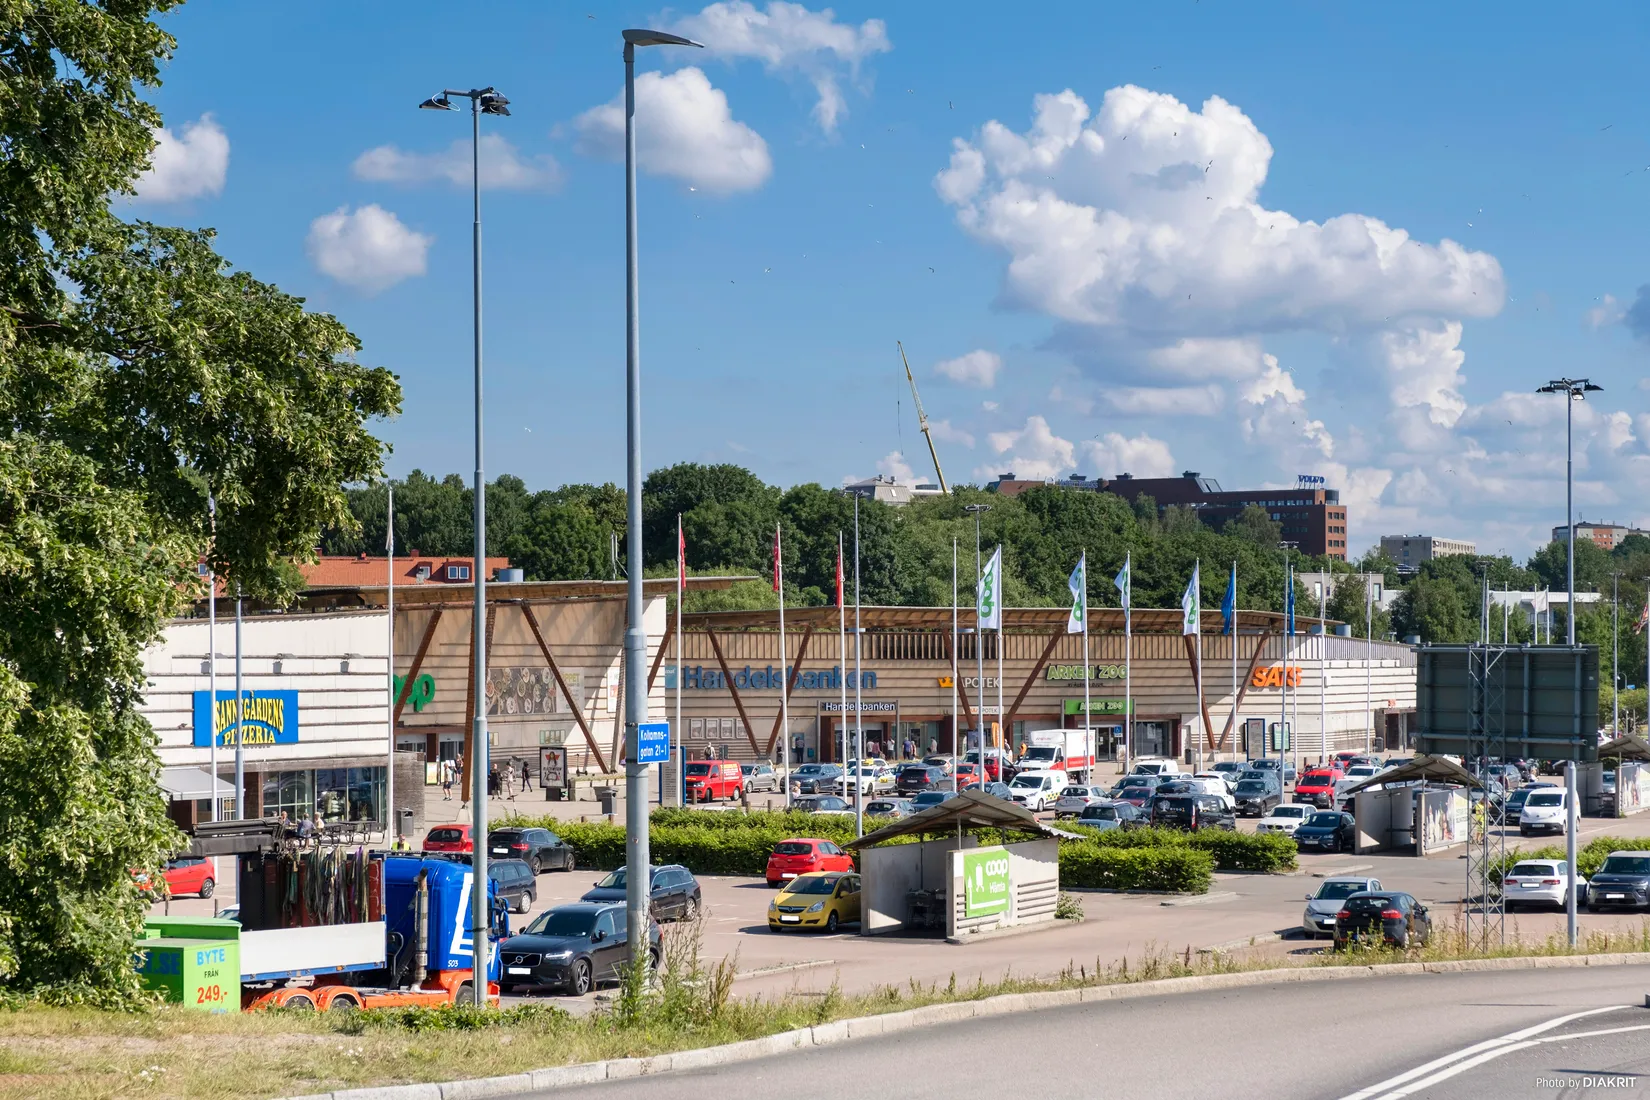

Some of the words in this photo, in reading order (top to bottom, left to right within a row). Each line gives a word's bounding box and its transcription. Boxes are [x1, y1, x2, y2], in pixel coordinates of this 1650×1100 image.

[1298, 475, 1325, 484] VOLVO
[684, 665, 877, 690] Handelsbanken
[1047, 665, 1095, 680] ARKEN
[1098, 665, 1128, 679] ZOO
[1252, 666, 1302, 687] SATS
[214, 691, 284, 736] SANNGÅRDENS
[825, 702, 895, 711] Handesbanken
[985, 858, 1008, 878] coop
[197, 949, 225, 966] BYTE
[204, 968, 219, 979] FRÅN
[197, 985, 228, 1004] 249,-
